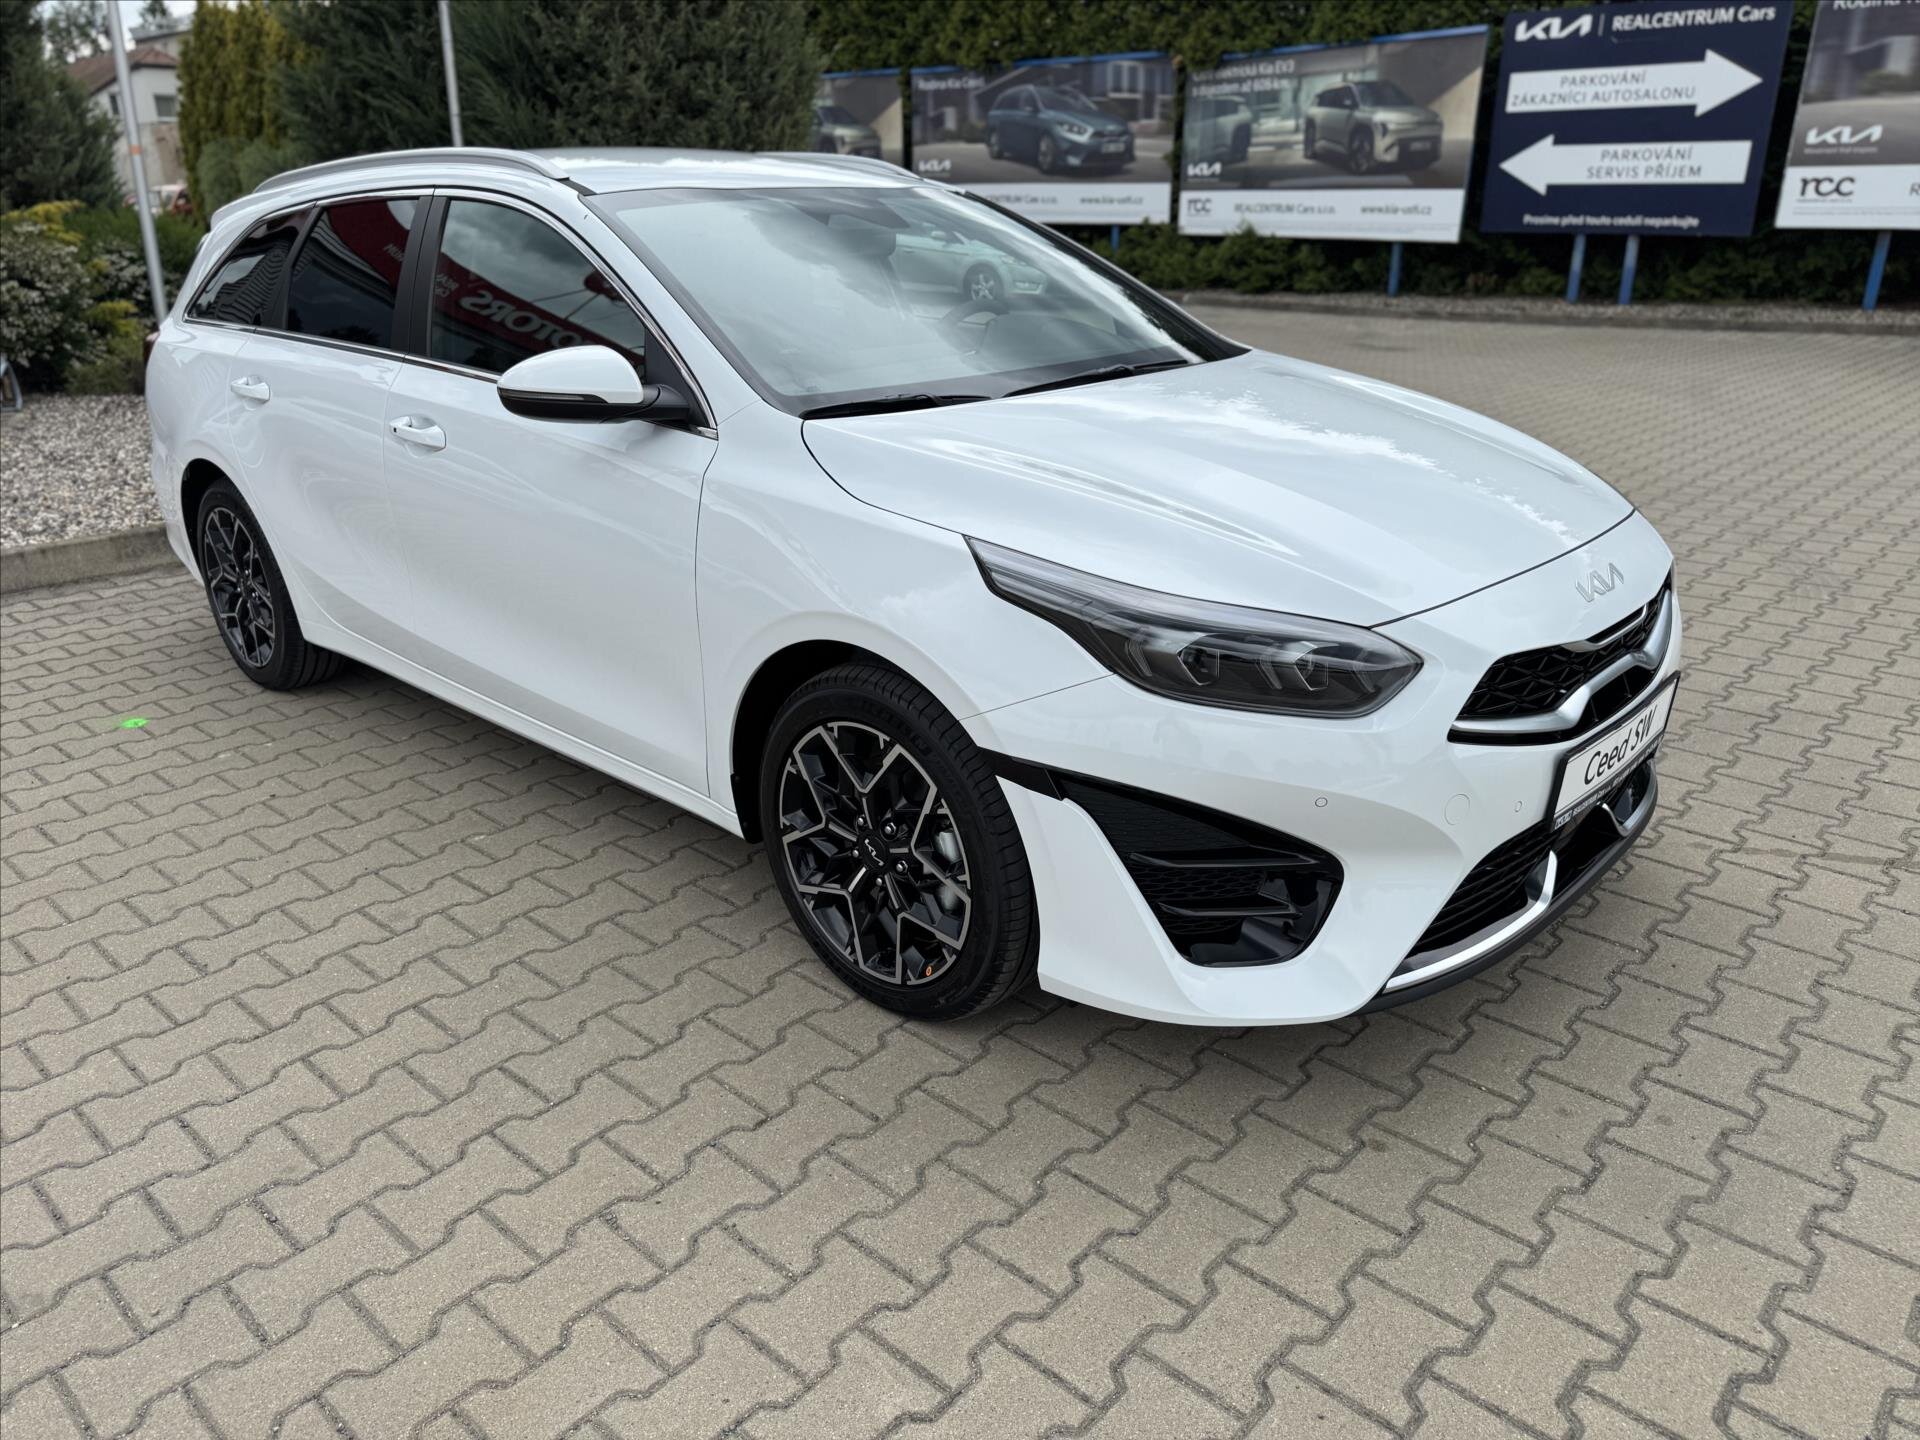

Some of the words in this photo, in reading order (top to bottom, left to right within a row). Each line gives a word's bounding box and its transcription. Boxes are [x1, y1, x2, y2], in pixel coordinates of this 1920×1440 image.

[1514, 14, 1593, 42] KIA
[1612, 8, 1735, 31] REALCENTRUM
[1737, 5, 1776, 23] Cars
[1560, 69, 1647, 88] PARKOVÁNÍ
[1511, 89, 1587, 107] ZÁKAZNÍCI
[1590, 86, 1697, 104] AUTOSALONU
[1805, 124, 1883, 145] KIA
[1600, 146, 1694, 163] PARKOVÁNÍ
[1587, 165, 1639, 180] SERVIS
[1643, 163, 1702, 179] PŘÍJEM
[1800, 176, 1856, 197] rcc
[1575, 562, 1624, 603] KIA
[1584, 727, 1633, 785] Ceed
[1630, 704, 1658, 752] SW
